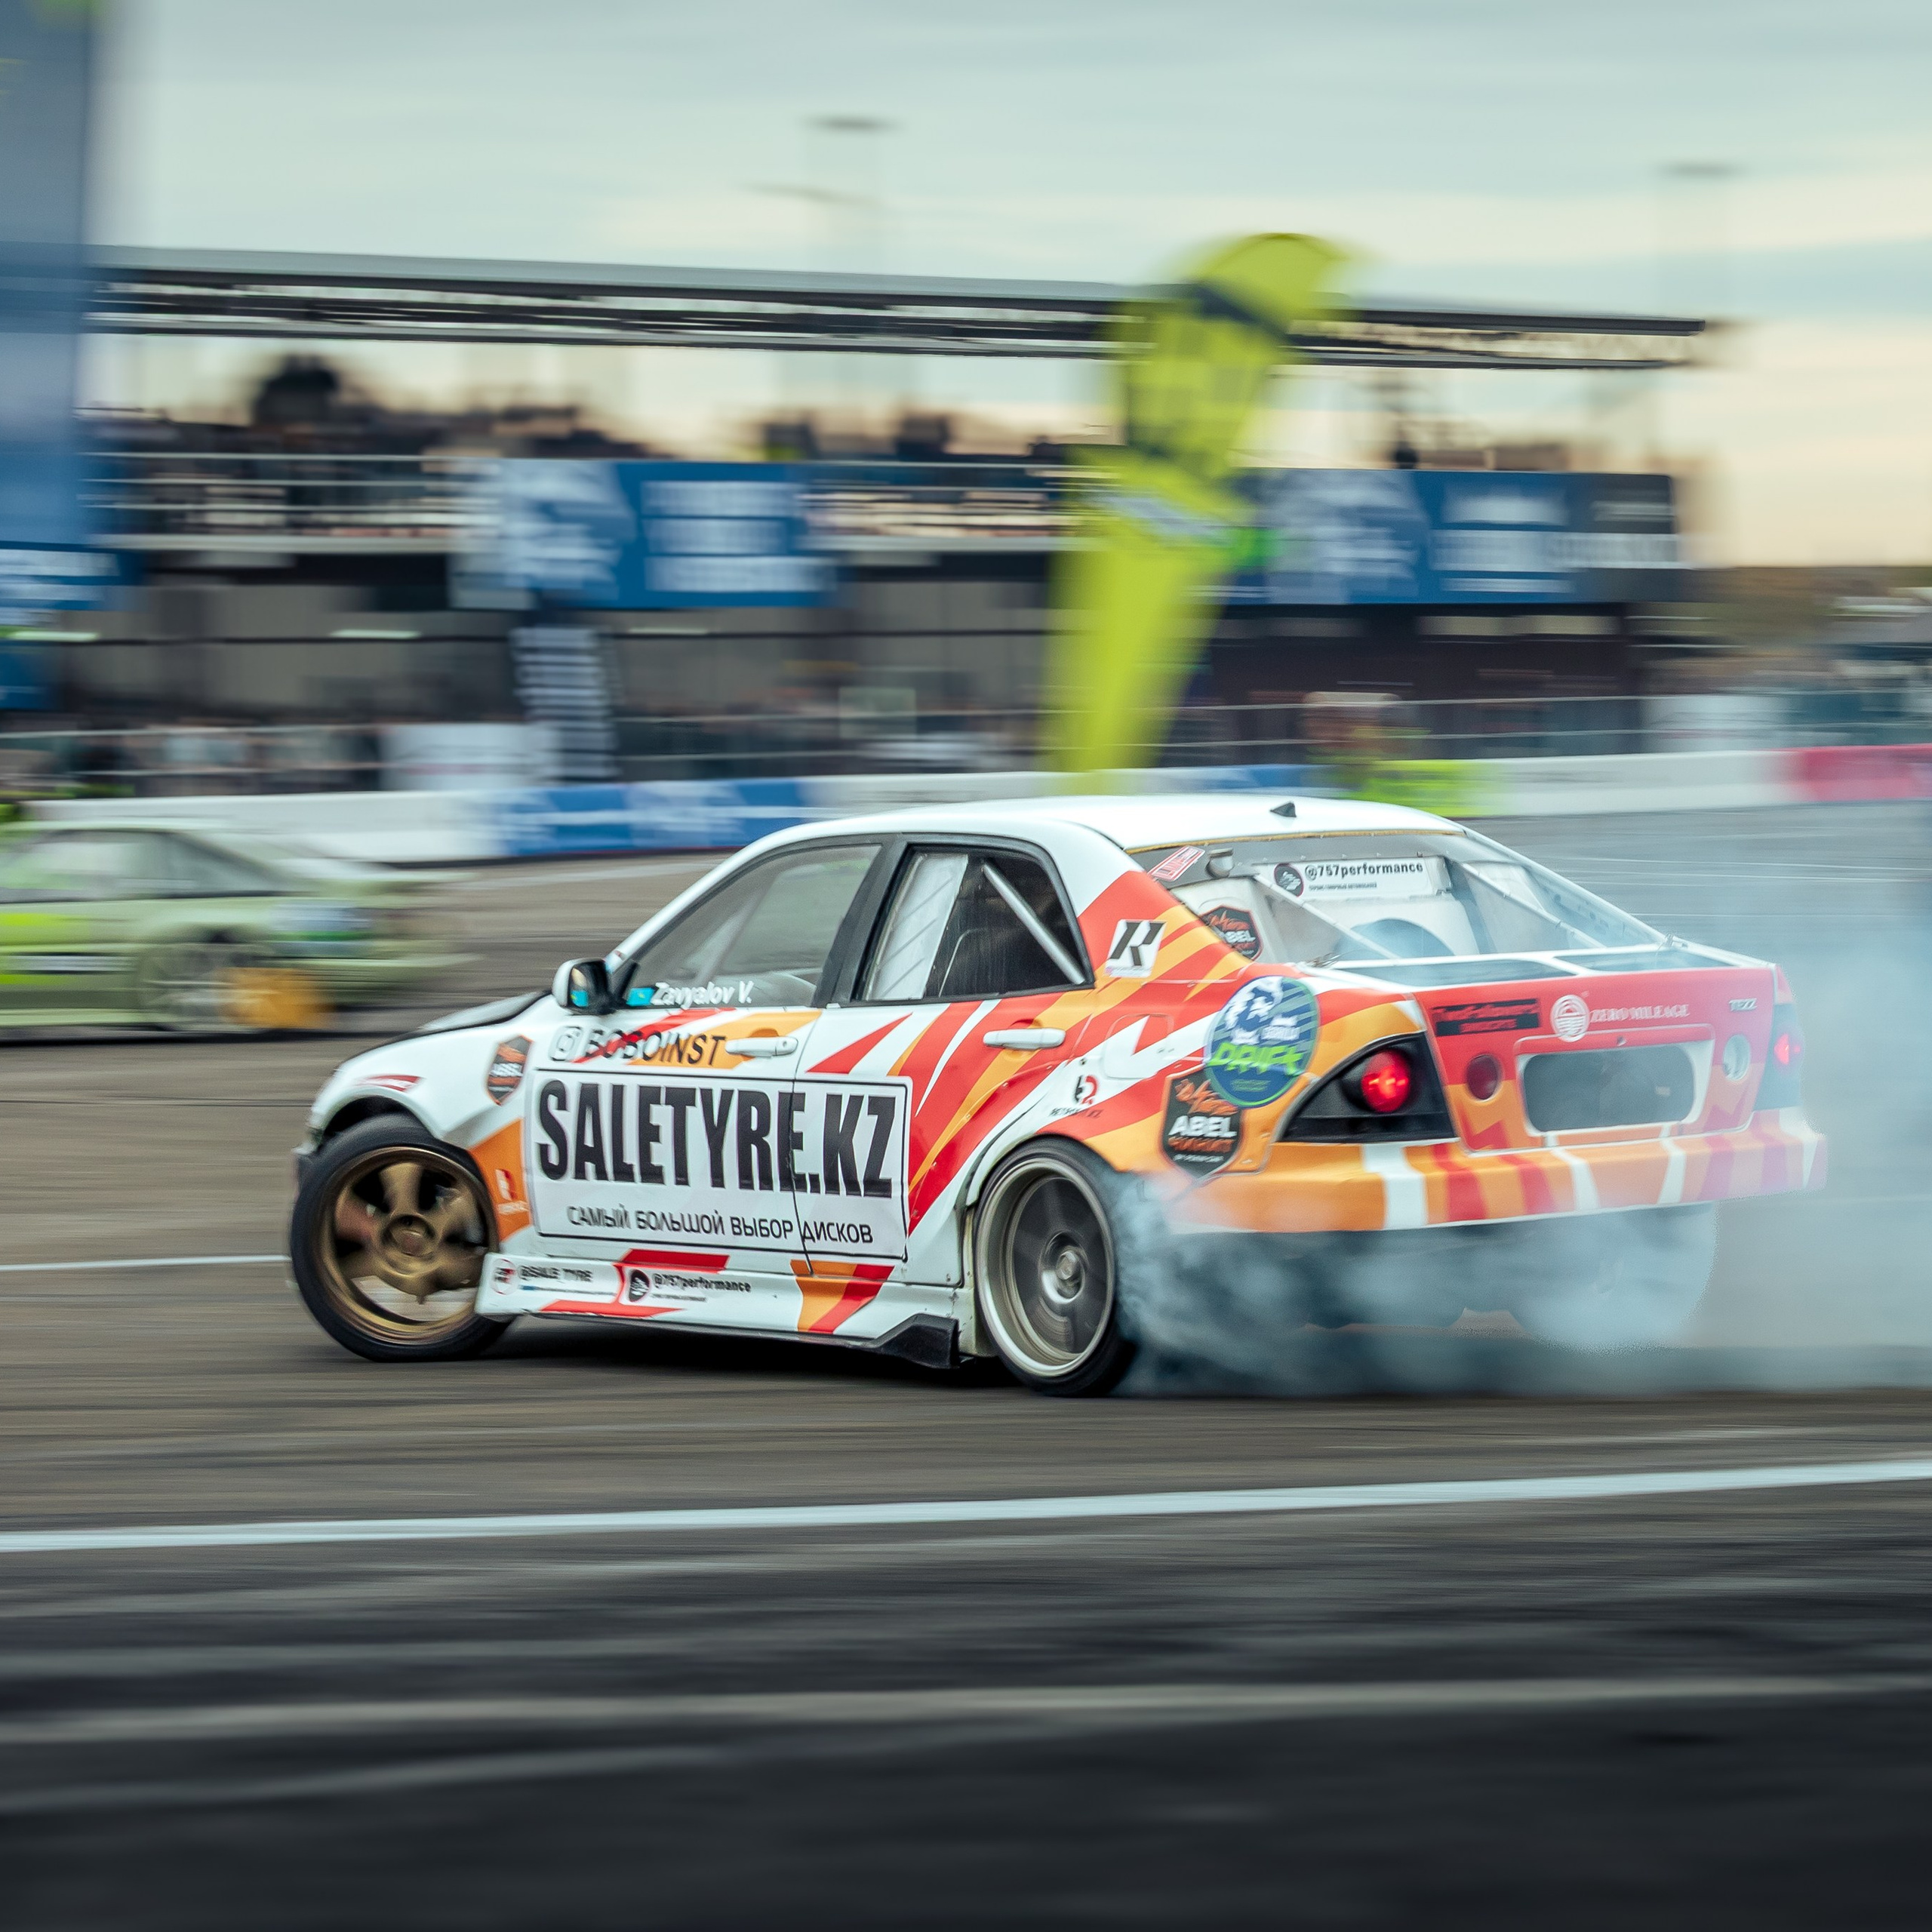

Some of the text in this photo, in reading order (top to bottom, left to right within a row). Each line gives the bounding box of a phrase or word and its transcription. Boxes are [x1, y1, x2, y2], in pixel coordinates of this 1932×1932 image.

[1305, 863, 1423, 881] @757performance
[650, 981, 737, 1010] Zavyalov
[538, 1078, 897, 1198] SALETYRE.KZ
[1168, 1115, 1238, 1139] ABEL
[567, 1203, 874, 1244] САМЫЙ БОЛЬШОЙ ВЫБОР ДИСКОВ
